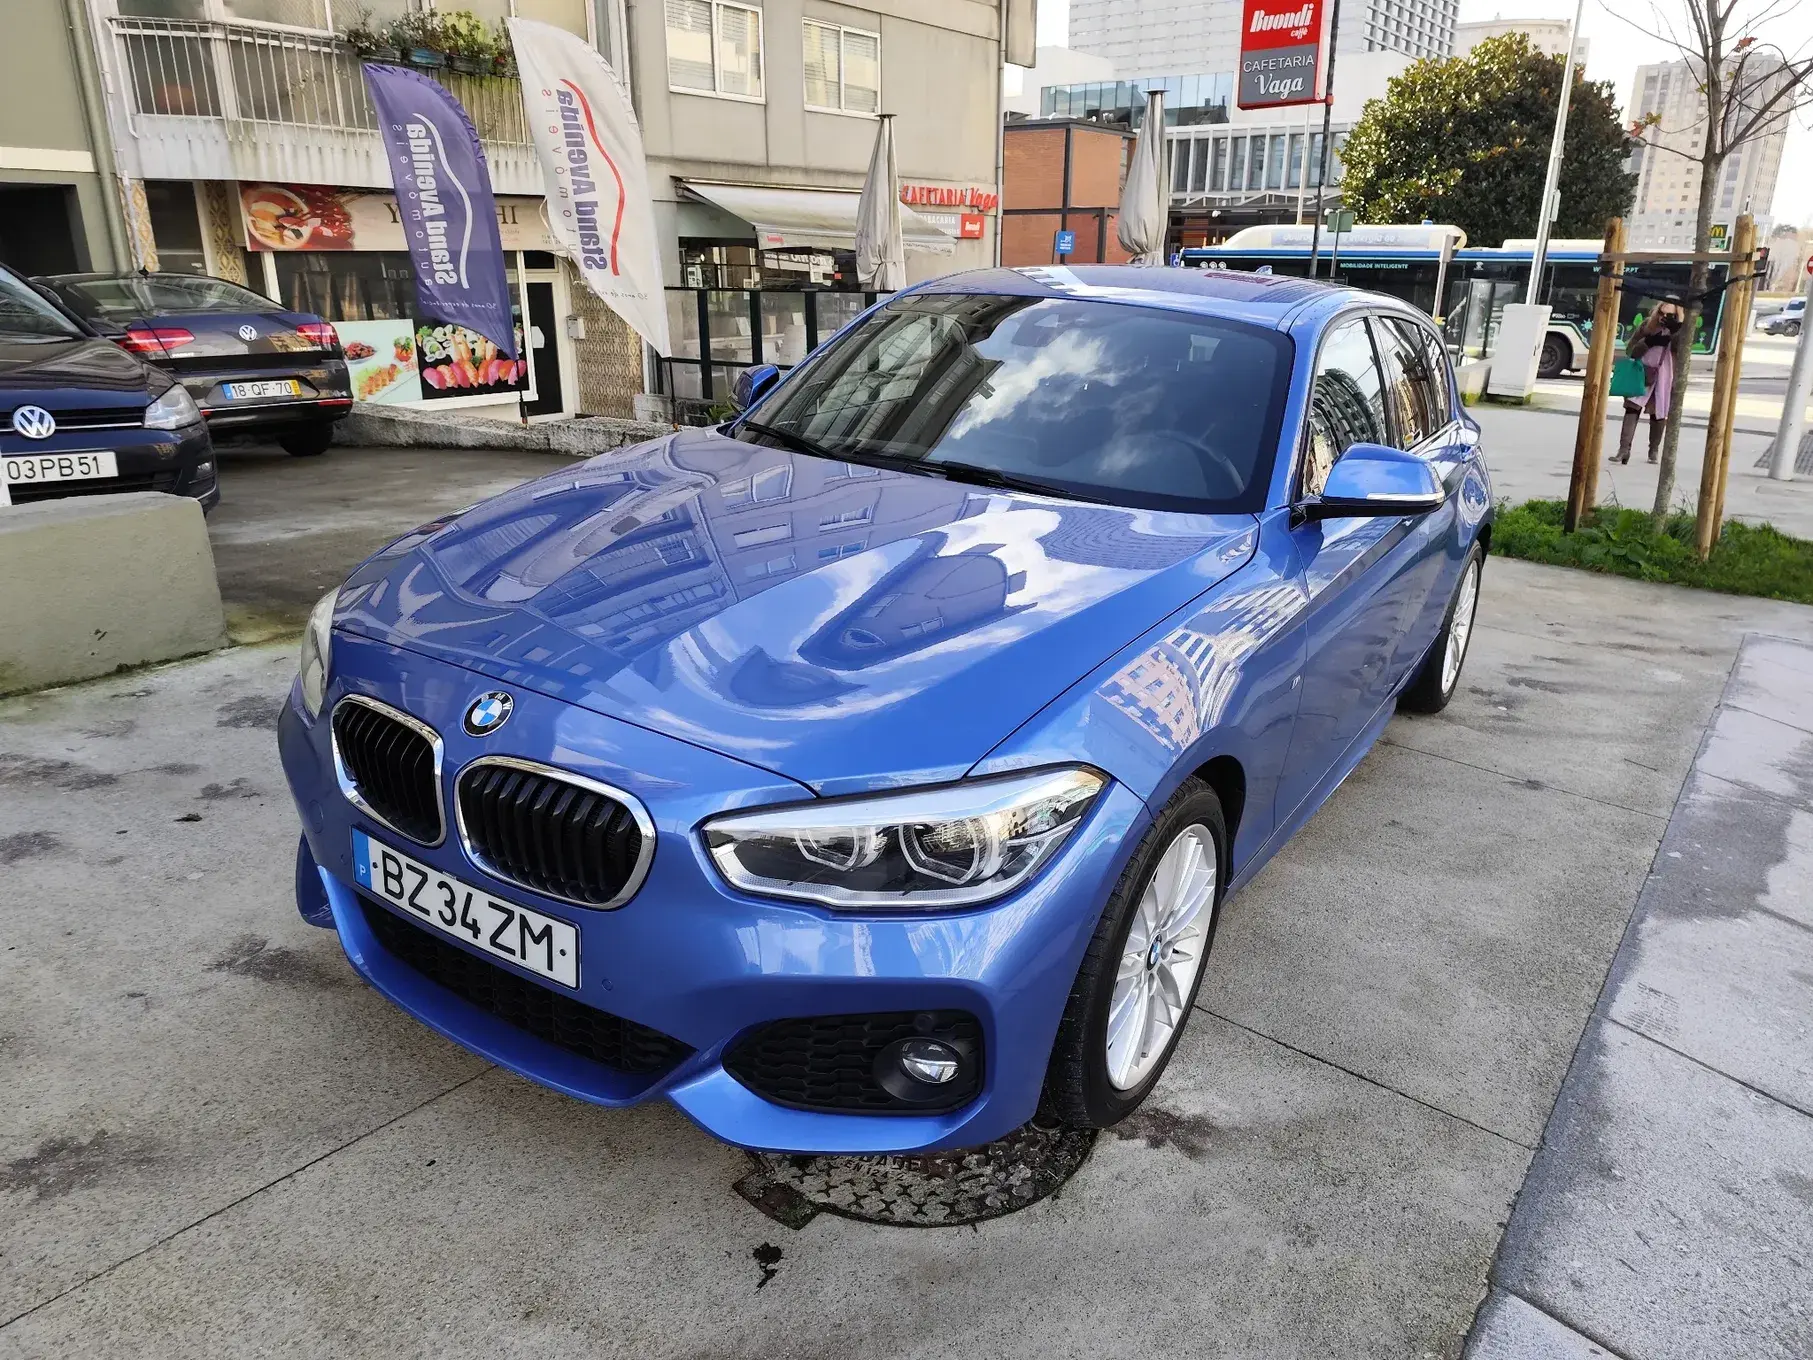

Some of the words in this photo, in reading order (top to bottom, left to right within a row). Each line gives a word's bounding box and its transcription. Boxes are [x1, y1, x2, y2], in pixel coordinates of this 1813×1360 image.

[1250, 3, 1314, 32] Buondi
[1243, 55, 1314, 72] CAFETARIA
[1254, 73, 1304, 99] Vaga
[902, 185, 966, 206] CAFETARIA
[970, 187, 999, 212] Vaga
[7, 456, 100, 480] 03PB51
[381, 850, 554, 972] BZ34ZM
